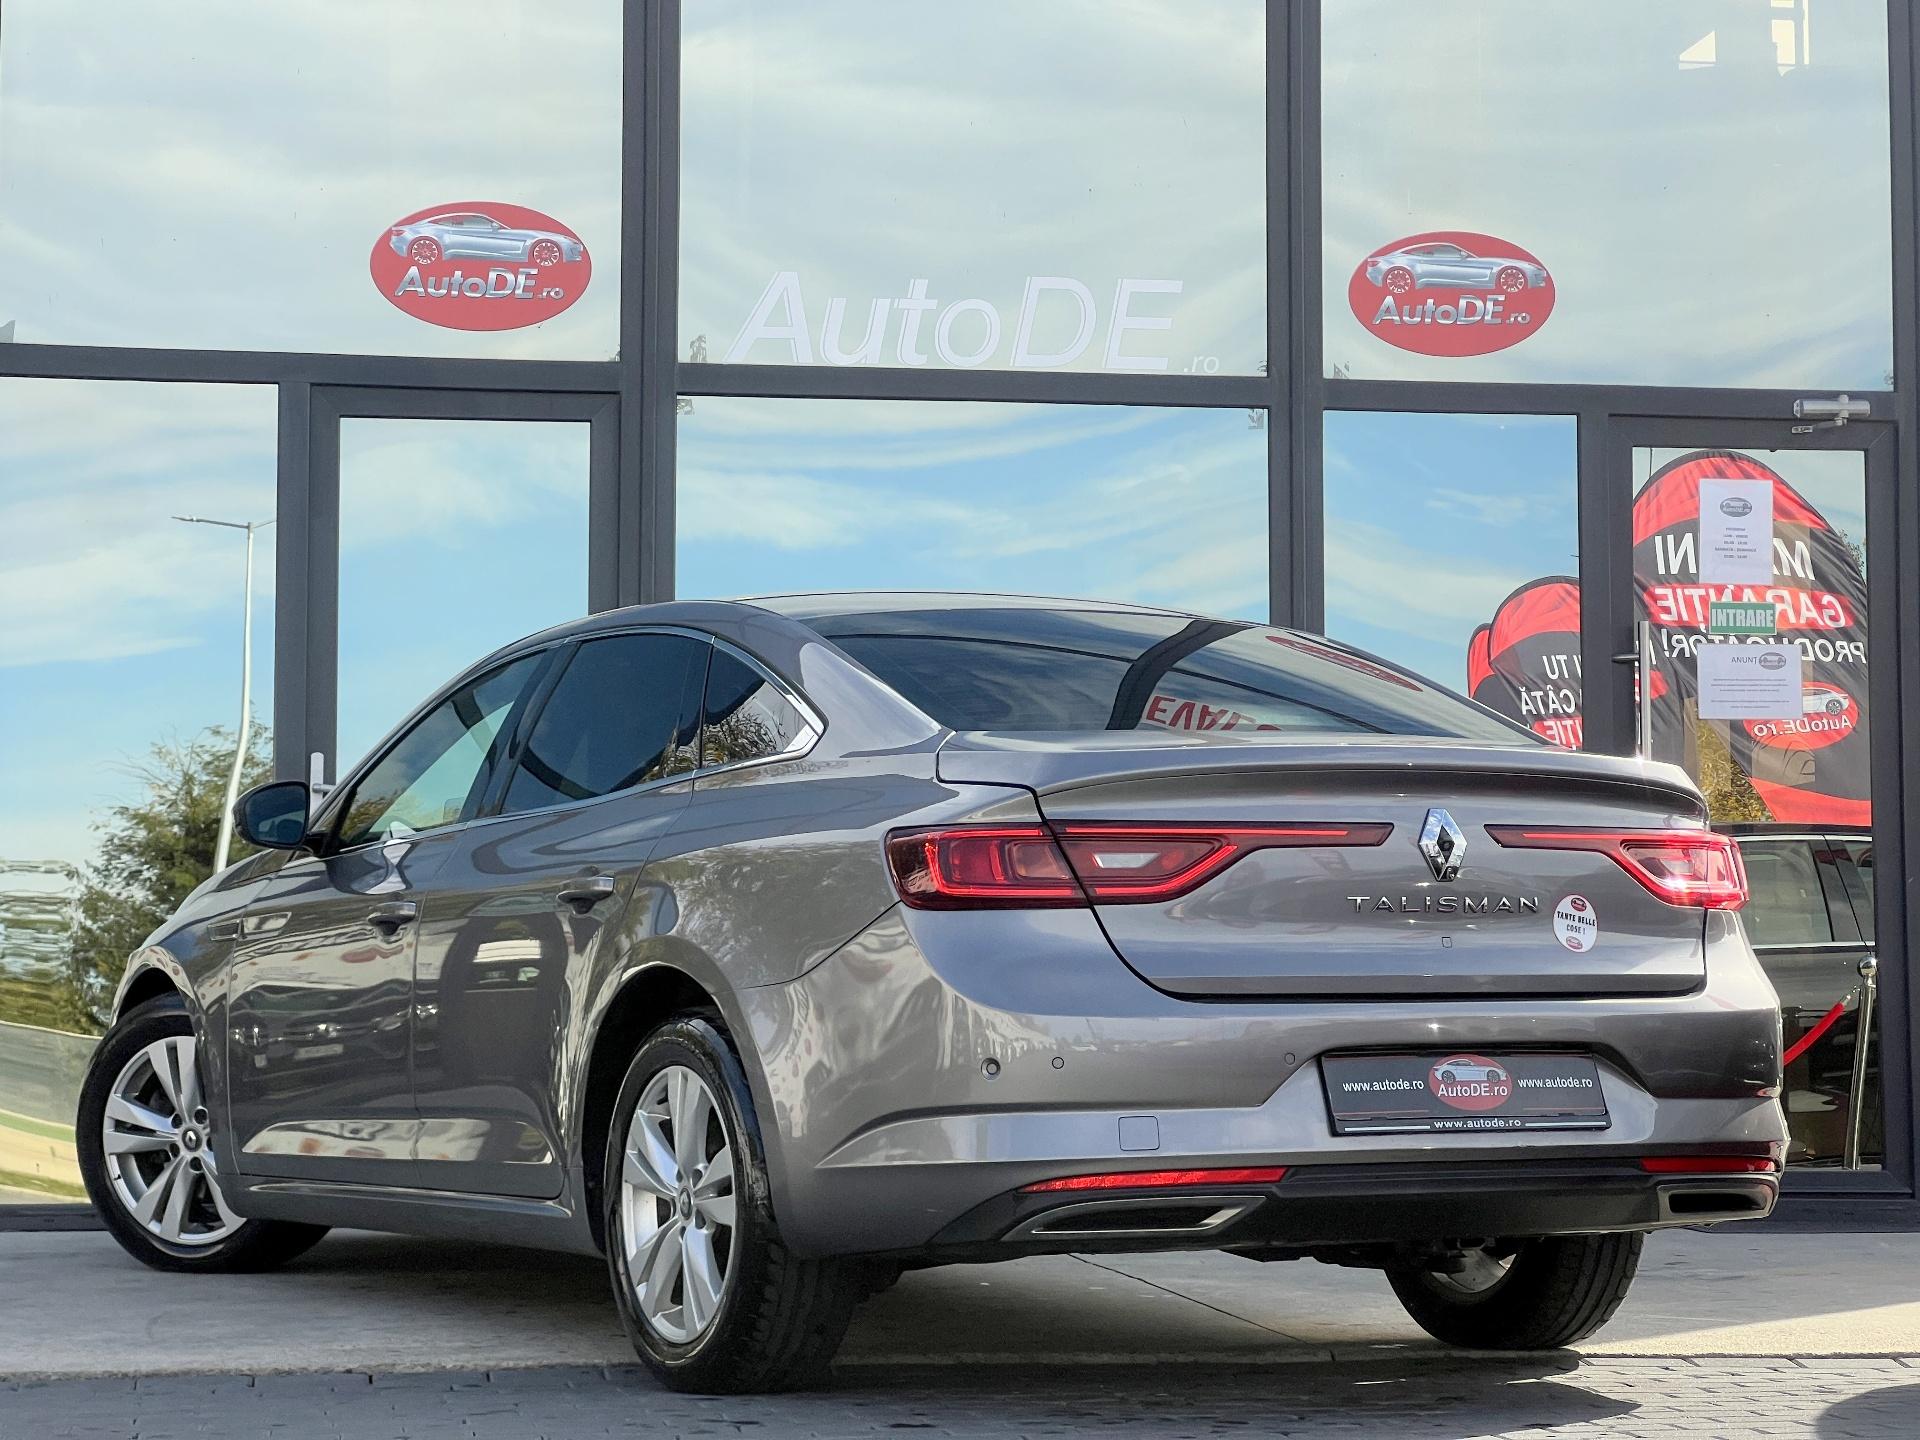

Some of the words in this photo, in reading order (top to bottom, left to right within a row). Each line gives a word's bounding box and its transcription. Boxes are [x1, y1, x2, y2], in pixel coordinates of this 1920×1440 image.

[1711, 608, 1775, 628] INTRARE
[1347, 896, 1539, 913] TALISMAN
[1557, 911, 1576, 922] TANTE
[1577, 915, 1596, 927] BELLE
[1342, 1079, 1425, 1092] www.autode.ro
[1437, 1083, 1508, 1098] AutoDE.ro
[1517, 1076, 1593, 1089] www.autode.ro
[1433, 1117, 1522, 1129] www.autode.ro
